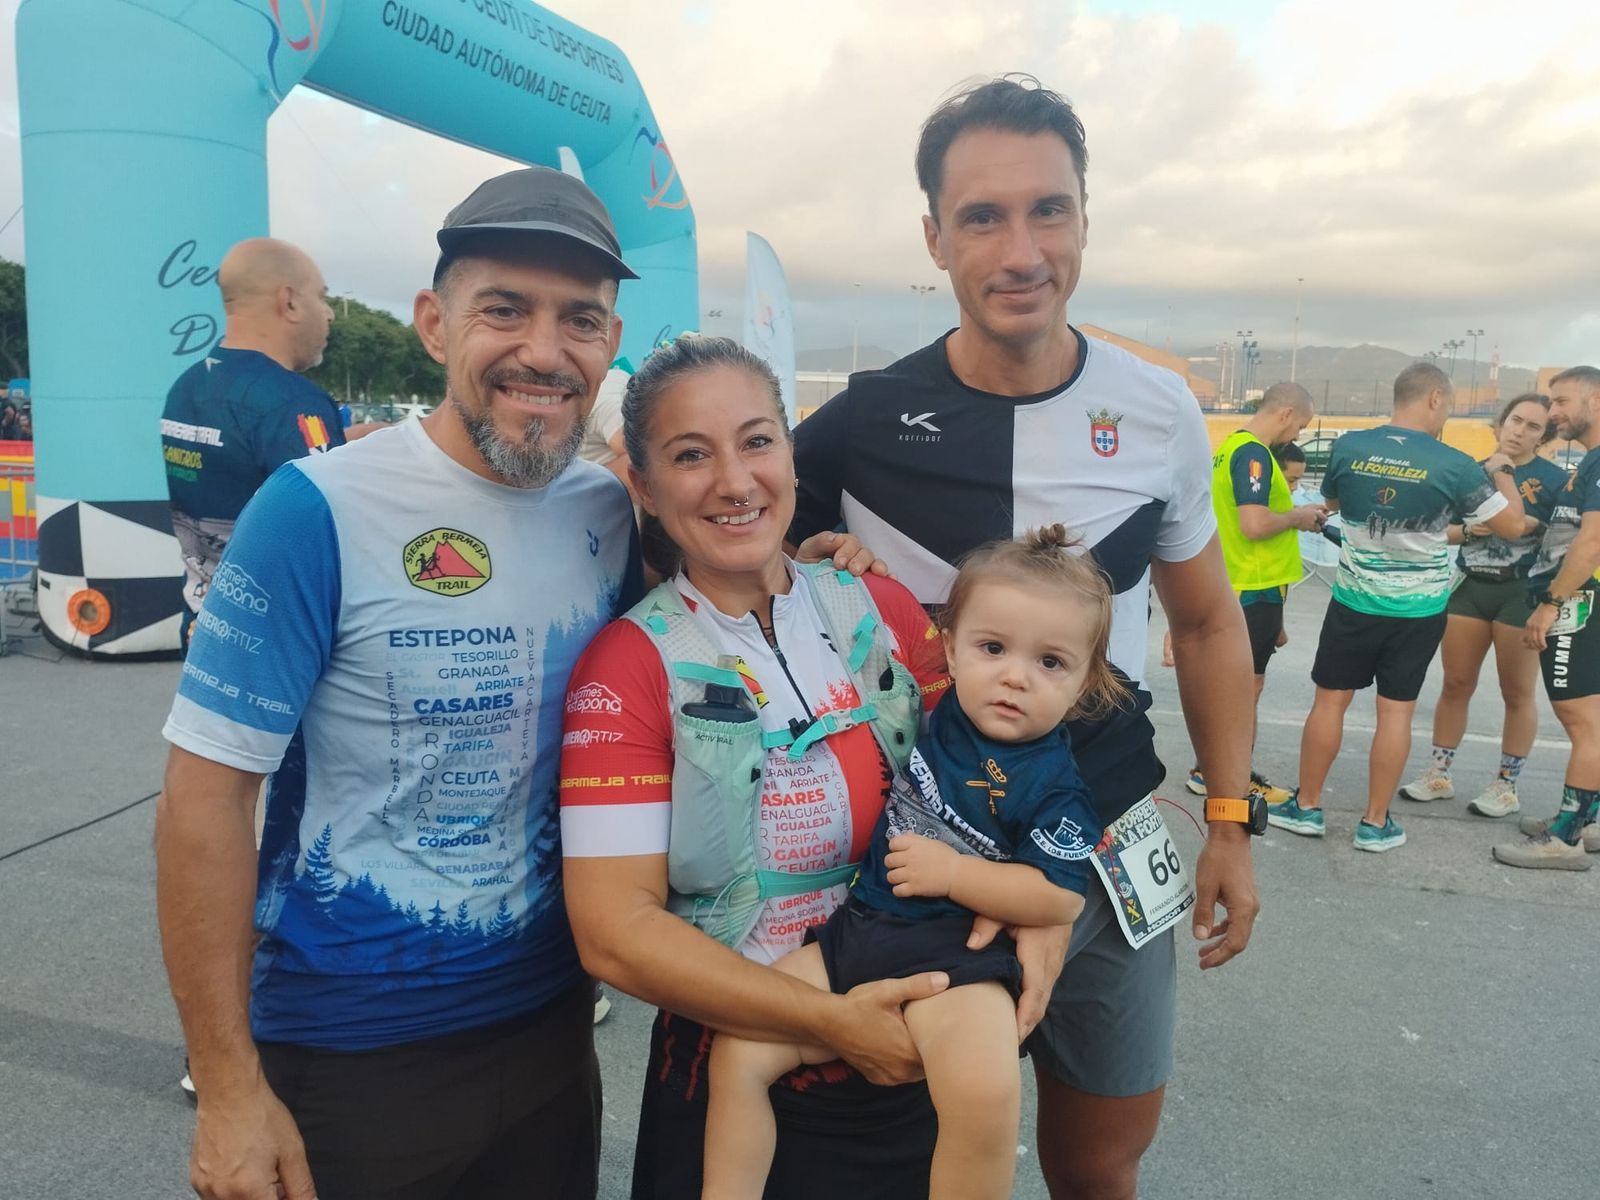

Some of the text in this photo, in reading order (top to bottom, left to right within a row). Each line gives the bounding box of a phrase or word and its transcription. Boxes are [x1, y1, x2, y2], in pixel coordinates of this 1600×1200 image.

[547, 26, 624, 84] DEPORTES
[381, 1, 612, 126] CIUDAD AUTÓNOMA DE CEUTA
[1351, 460, 1364, 471] LA
[1364, 462, 1428, 480] FORTALEZA
[405, 532, 488, 564] SIERRA BERMEJA
[436, 580, 471, 590] TRAIL
[389, 626, 517, 648] ESTEPONA
[452, 649, 519, 663] TESORILLO
[438, 665, 510, 680] GRANADA
[475, 676, 525, 692] ARRIATE
[413, 692, 514, 715] CASARES
[418, 709, 521, 727] GENALGUACIL
[449, 723, 511, 740] IGUALEJA
[442, 739, 494, 754] TARIFA
[413, 732, 440, 822] RONDA
[441, 770, 500, 785] CEUTA
[790, 773, 830, 789] ARRIATE
[439, 786, 506, 798] MONTEJAQUE
[761, 788, 826, 807] ASARES
[436, 813, 497, 826] UBRIQUE
[761, 802, 836, 821] ENALGUACIL
[417, 825, 455, 836] MEDINA
[776, 816, 832, 832] IGUALEJA
[417, 834, 491, 849] CÓRDOBA
[772, 832, 820, 846] TARIFA
[1047, 846, 1062, 857] LOS
[1147, 838, 1181, 887] 66
[472, 875, 513, 888] ARAHAL
[778, 889, 823, 911] UBRIQUE
[765, 912, 796, 924] MEDINA
[768, 914, 829, 935] CÓRDOBA
